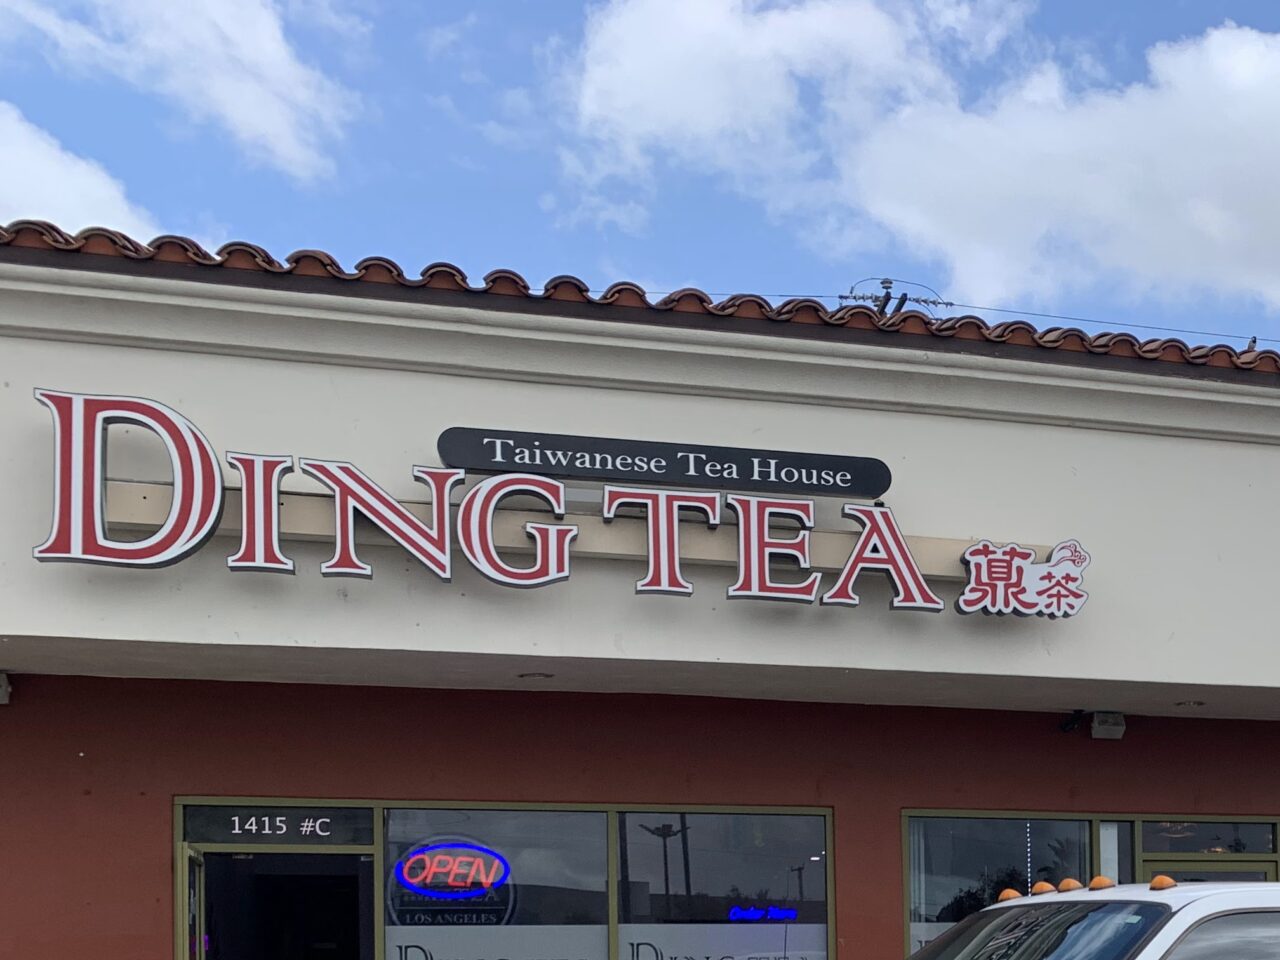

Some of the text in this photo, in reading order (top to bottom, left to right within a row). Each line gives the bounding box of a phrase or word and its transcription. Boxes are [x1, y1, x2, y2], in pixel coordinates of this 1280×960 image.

[482, 438, 852, 488] Taiwanese Tea House
[33, 387, 945, 611] DING TEA
[230, 816, 331, 836] 1415 #C
[402, 854, 500, 888] OPEN
[405, 913, 497, 924] LOS ANGELES
